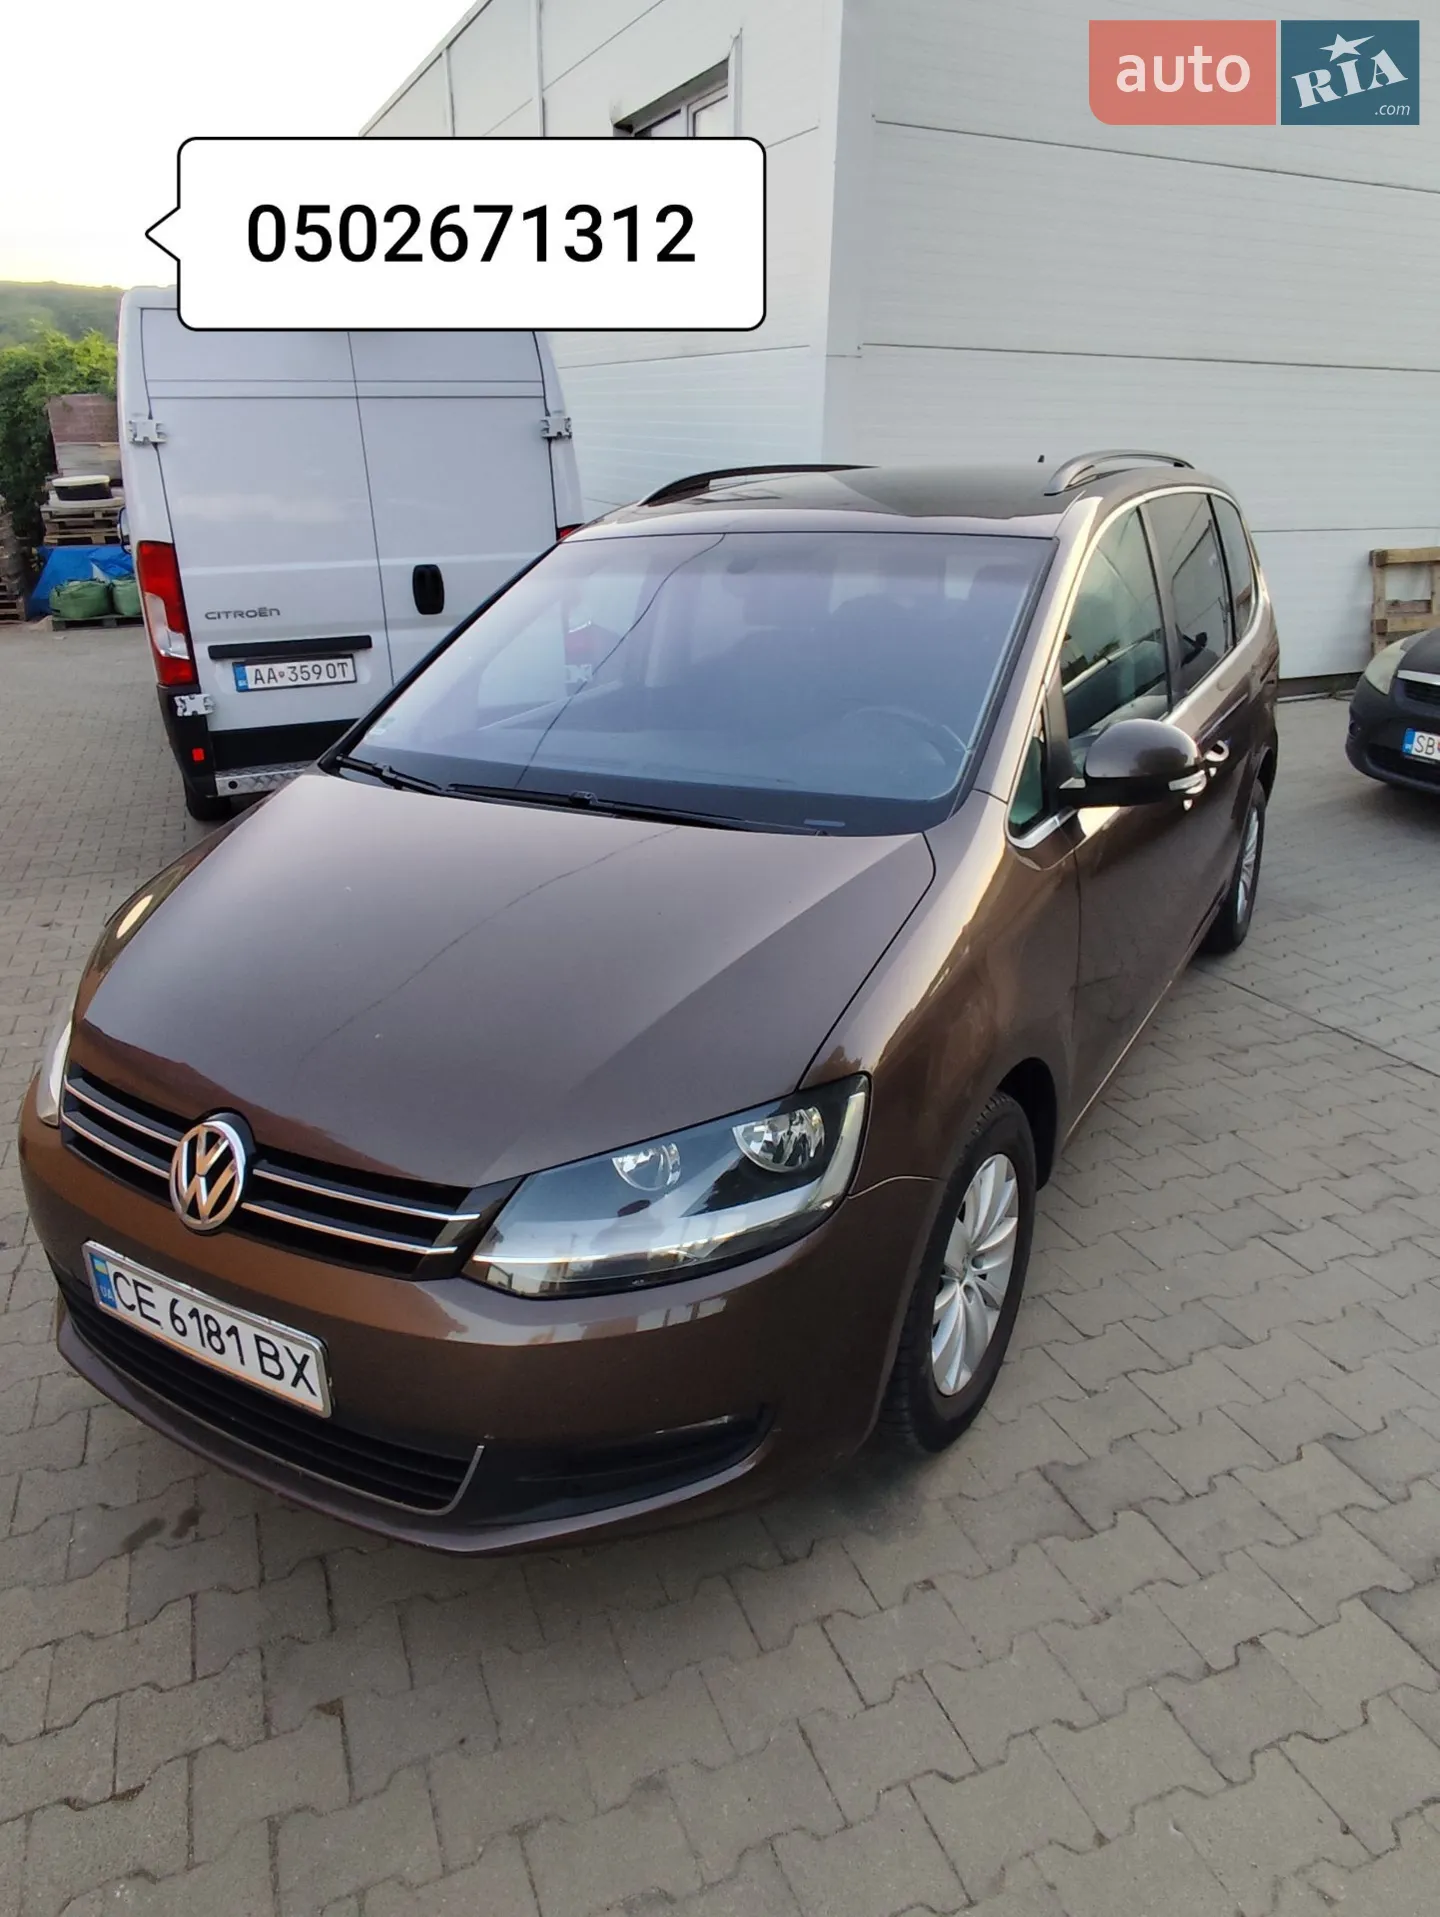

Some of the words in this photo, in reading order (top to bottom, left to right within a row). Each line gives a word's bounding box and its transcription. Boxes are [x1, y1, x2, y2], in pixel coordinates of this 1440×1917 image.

[101, 1286, 113, 1300] UA
[113, 1271, 161, 1327] CE
[169, 1298, 246, 1366] 6181
[254, 1333, 318, 1397] BX
